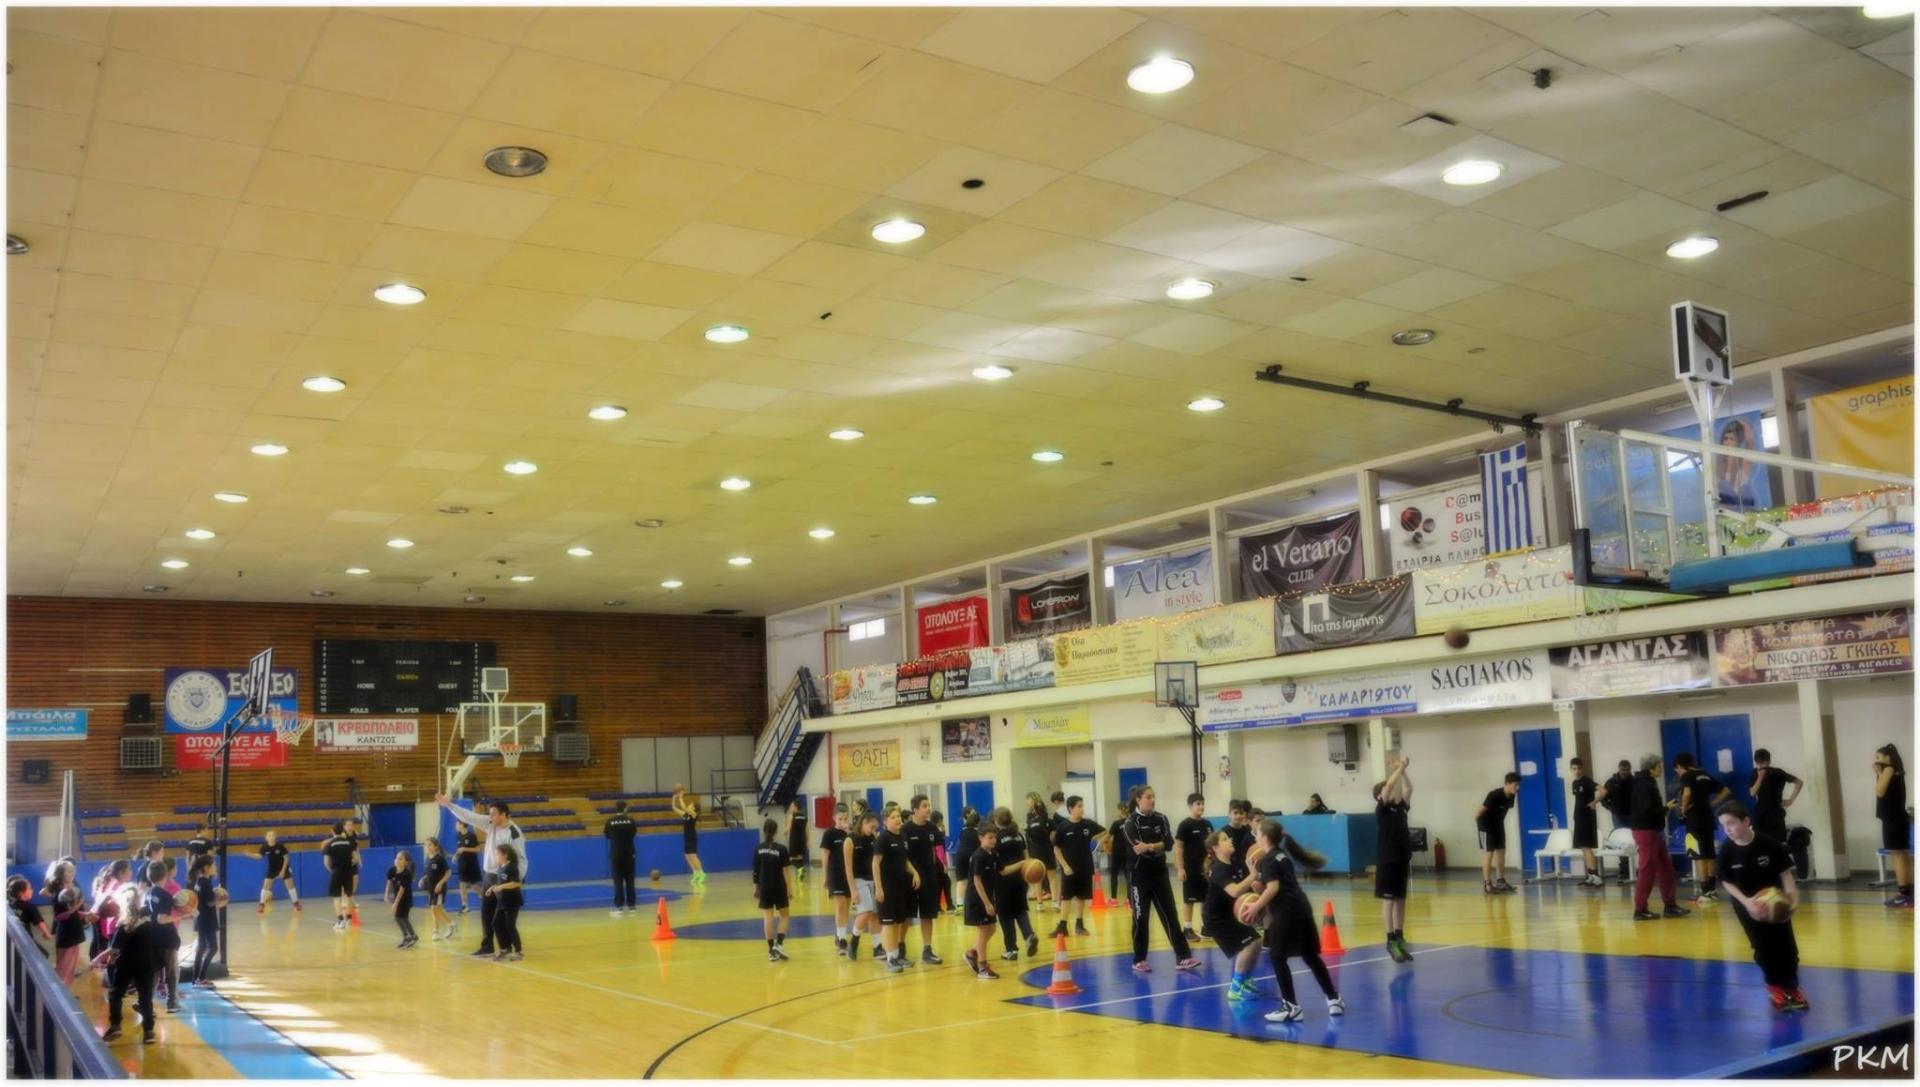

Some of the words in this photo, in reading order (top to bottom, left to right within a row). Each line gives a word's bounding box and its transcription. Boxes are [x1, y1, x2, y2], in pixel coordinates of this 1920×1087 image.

[1848, 384, 1914, 411] graphis
[1445, 493, 1481, 508] C@m
[1455, 511, 1481, 524] Bus
[1252, 546, 1268, 572] el
[1273, 535, 1352, 568] Verano
[1448, 546, 1486, 561] ΠΛΗΡΟ
[1288, 569, 1315, 584] CLUB
[925, 608, 965, 629] ΩΤΟΛΟΥΞ
[1567, 634, 1689, 668] ΑΓΑΝΤΑΣ
[1767, 647, 1839, 666] ΝΙΚΟΛΑΟΣ
[1847, 641, 1900, 659] ΓΚΙΚΑΣ
[1431, 657, 1534, 690] SAGIAKOS
[253, 736, 270, 746] ΑΕ
[357, 736, 397, 744] ΚΑΝΤΖΟΣ
[852, 748, 889, 768] ΟΑΣΗ
